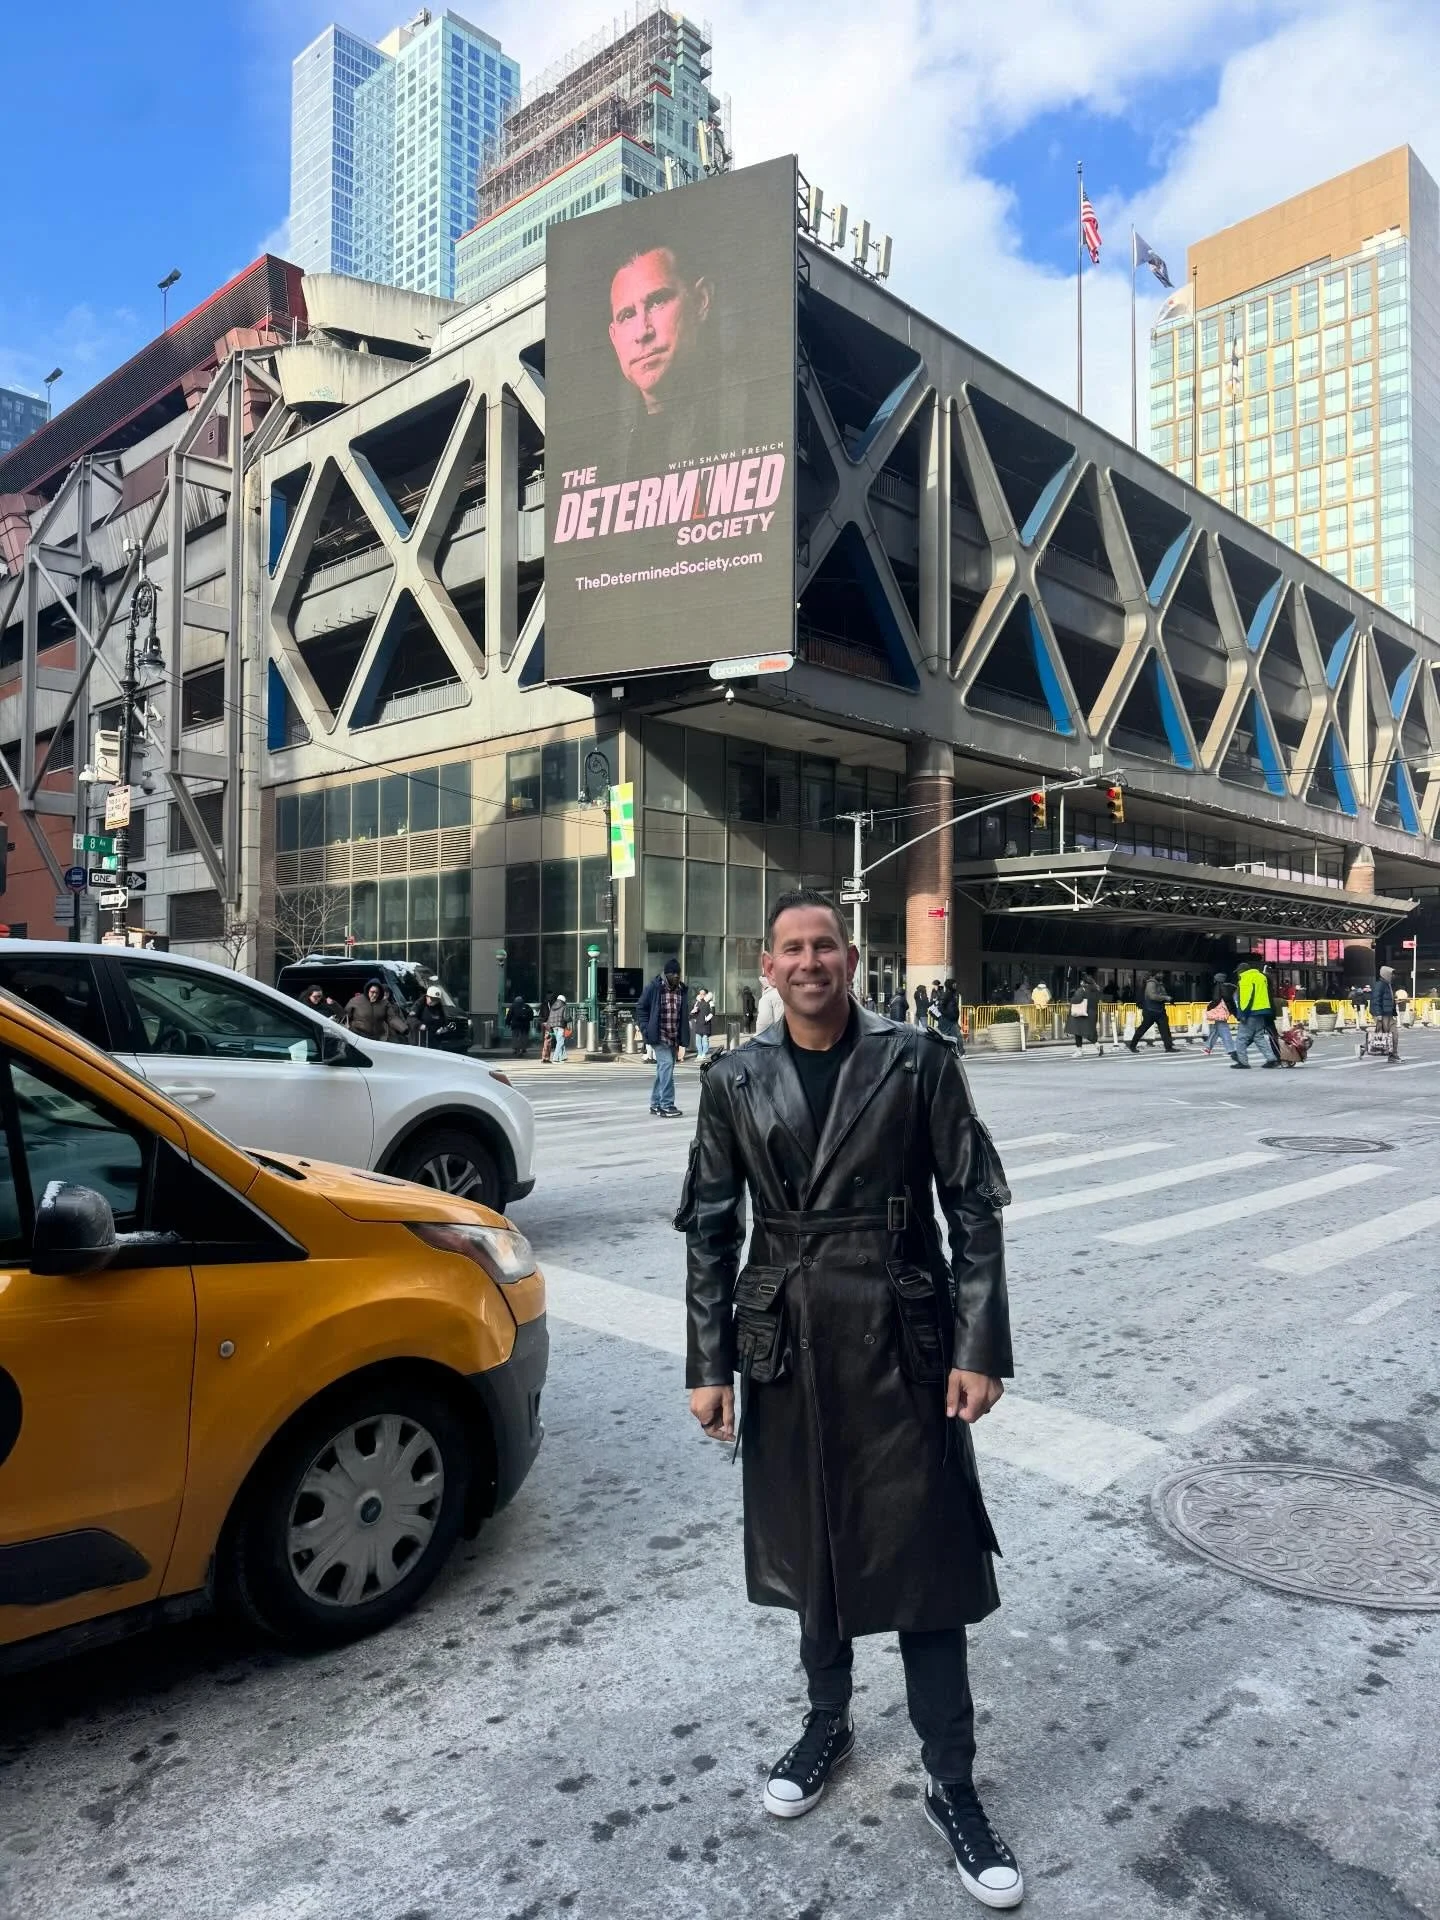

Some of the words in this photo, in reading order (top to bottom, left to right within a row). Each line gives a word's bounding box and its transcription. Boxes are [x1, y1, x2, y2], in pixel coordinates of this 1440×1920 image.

[668, 460, 695, 470] WITH
[699, 451, 736, 464] SHAWN
[741, 441, 784, 456] FRENCH
[561, 466, 598, 489] THE
[553, 453, 786, 544] DETERMINED
[676, 511, 776, 546] SOCIETY
[575, 552, 763, 591] TheDeterminedSociety.com
[90, 838, 96, 849] 8
[93, 874, 112, 883] ONE
